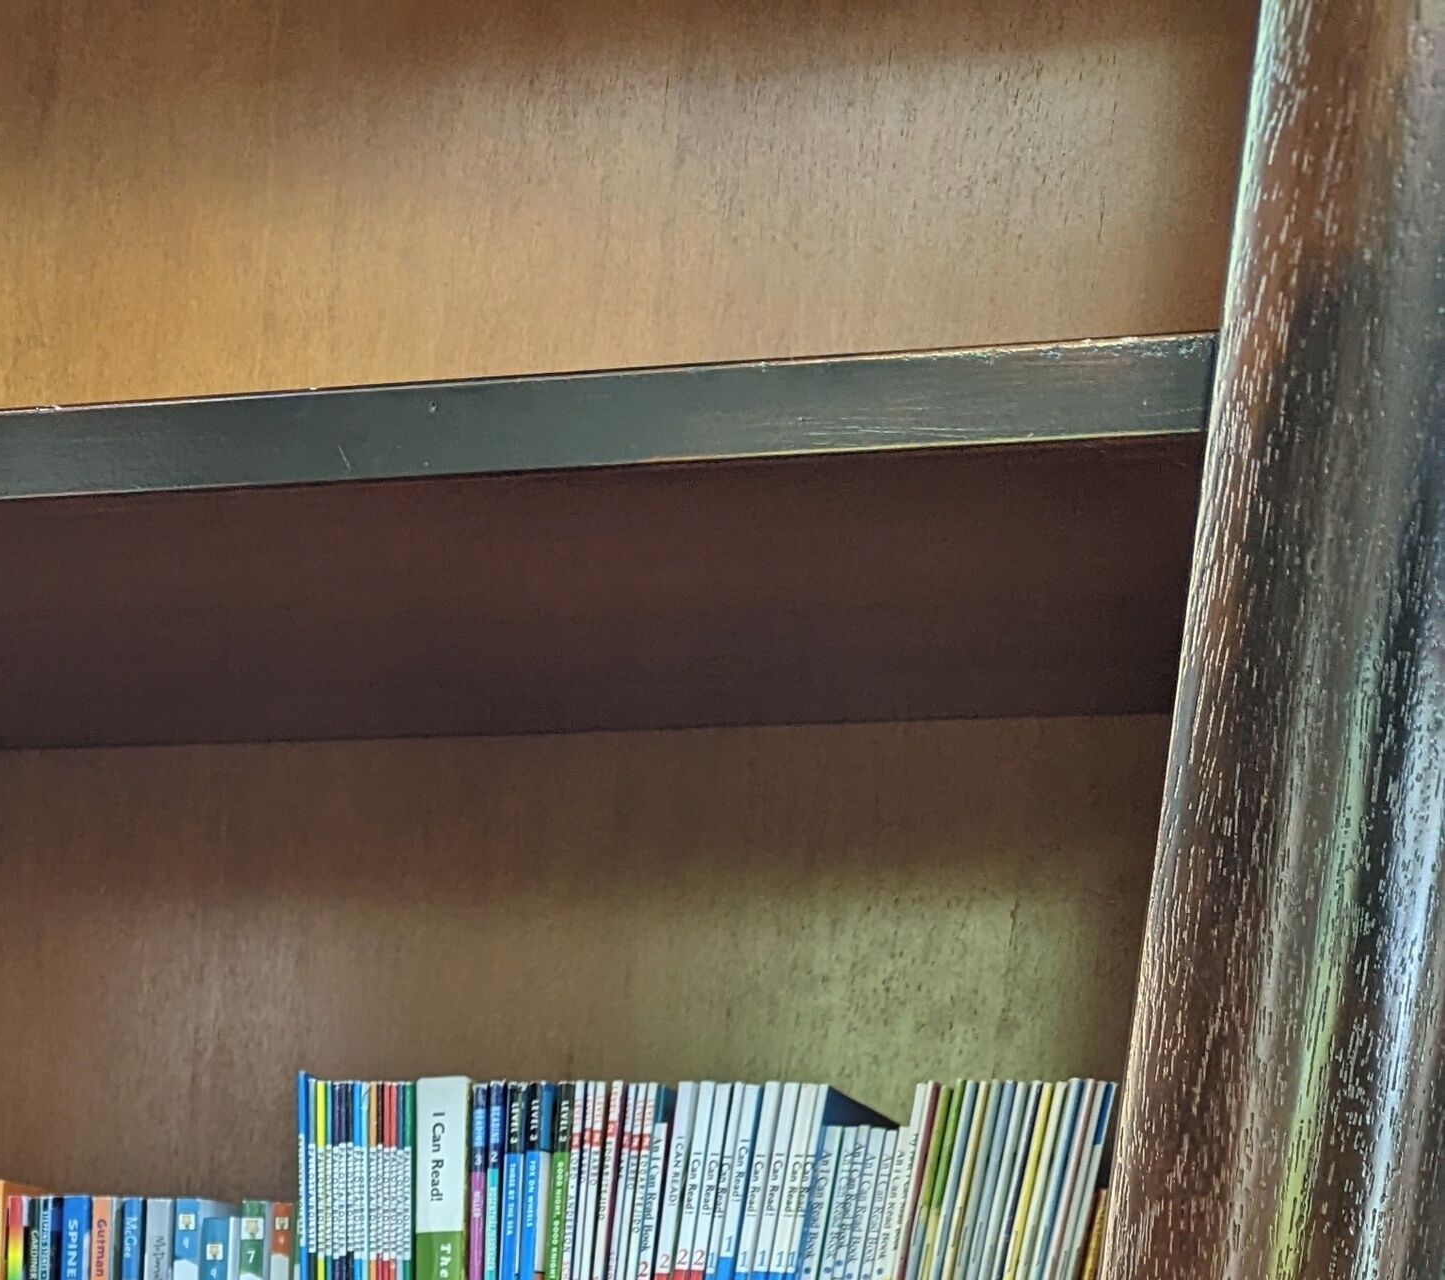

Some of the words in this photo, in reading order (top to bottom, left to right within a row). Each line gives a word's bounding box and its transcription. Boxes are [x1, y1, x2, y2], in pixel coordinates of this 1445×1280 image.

[431, 1123, 445, 1153] Can
[431, 1158, 444, 1202] Read!
[96, 1218, 108, 1277] Gutman
[124, 1216, 138, 1258] McGee
[247, 1249, 255, 1263] 7
[439, 1242, 452, 1279] The
